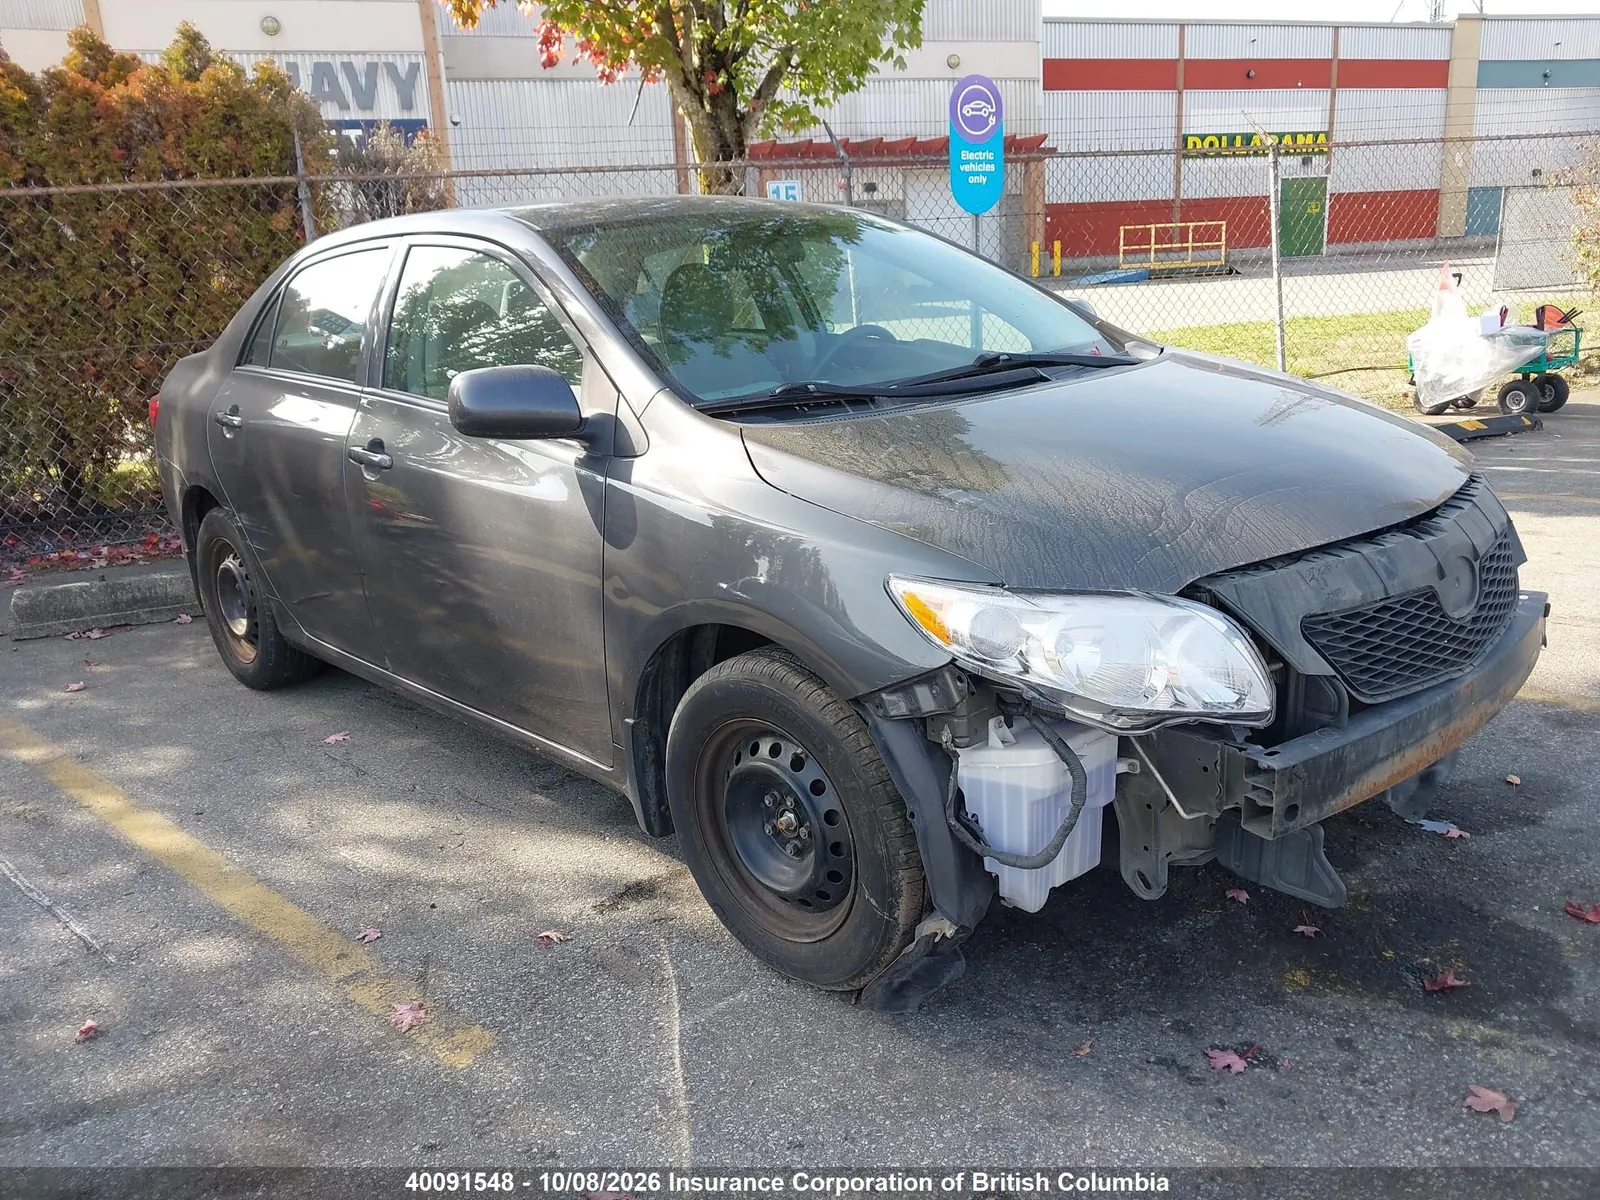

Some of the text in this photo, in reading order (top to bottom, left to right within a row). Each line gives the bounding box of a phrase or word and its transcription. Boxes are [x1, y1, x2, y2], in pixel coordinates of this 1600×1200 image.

[285, 61, 421, 110] AVY
[960, 150, 995, 160] Electric
[959, 161, 996, 172] vehicles
[968, 174, 987, 185] only
[772, 185, 798, 201] 15
